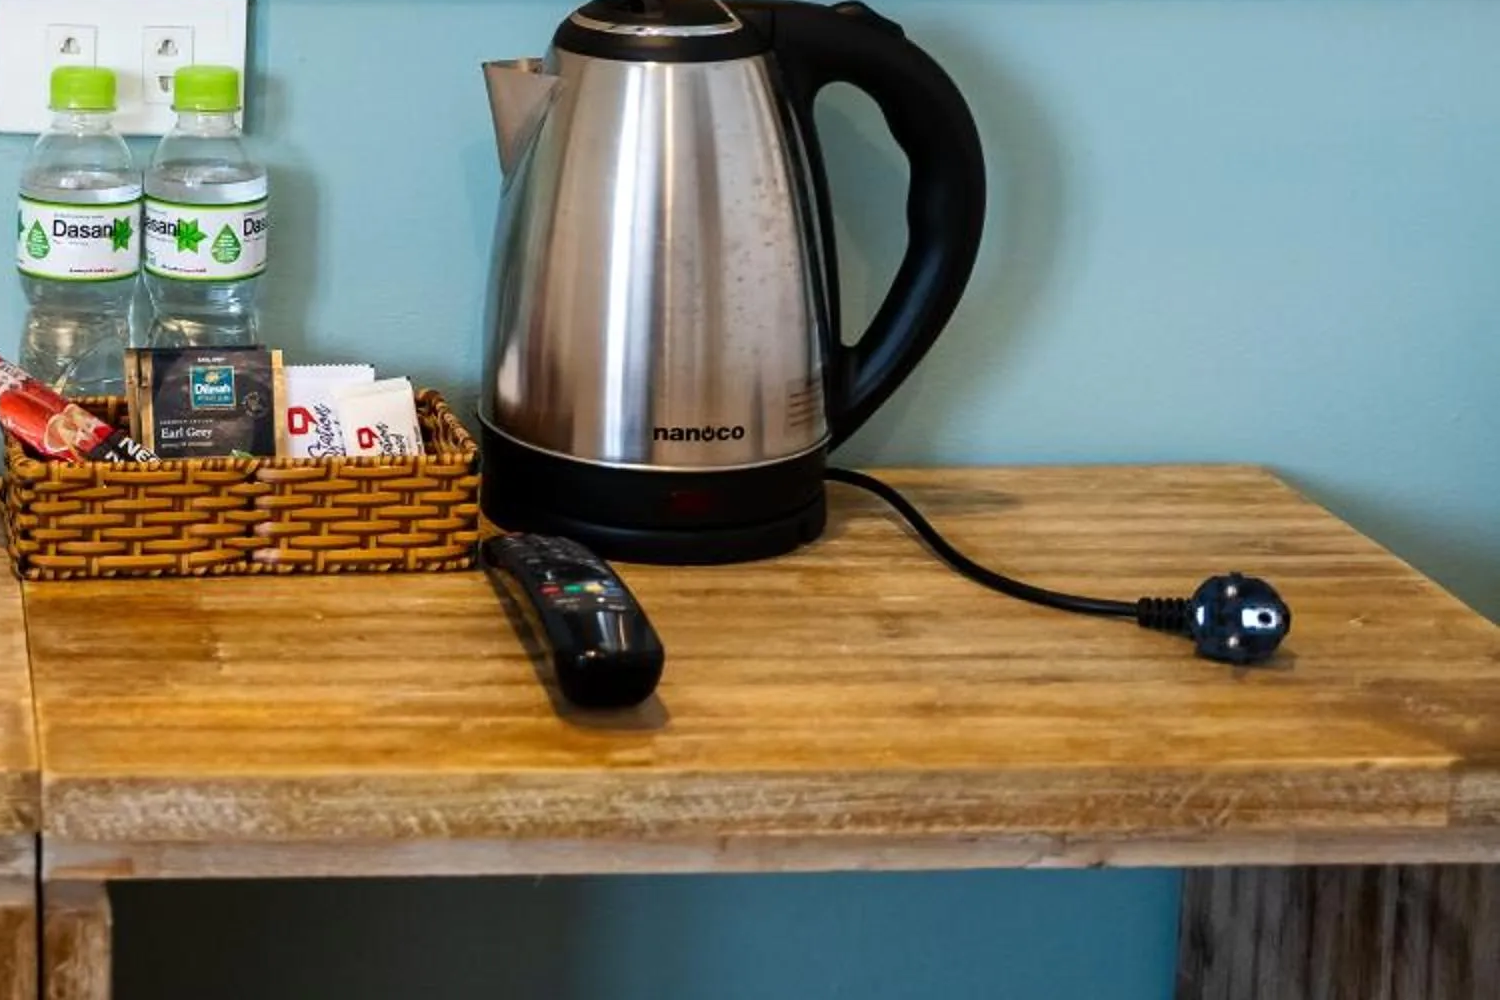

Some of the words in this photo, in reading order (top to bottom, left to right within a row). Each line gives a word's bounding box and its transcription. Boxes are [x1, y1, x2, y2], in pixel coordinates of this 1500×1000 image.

[161, 427, 184, 439] Earl
[185, 427, 213, 439] Grey
[653, 426, 745, 442] nanoco
